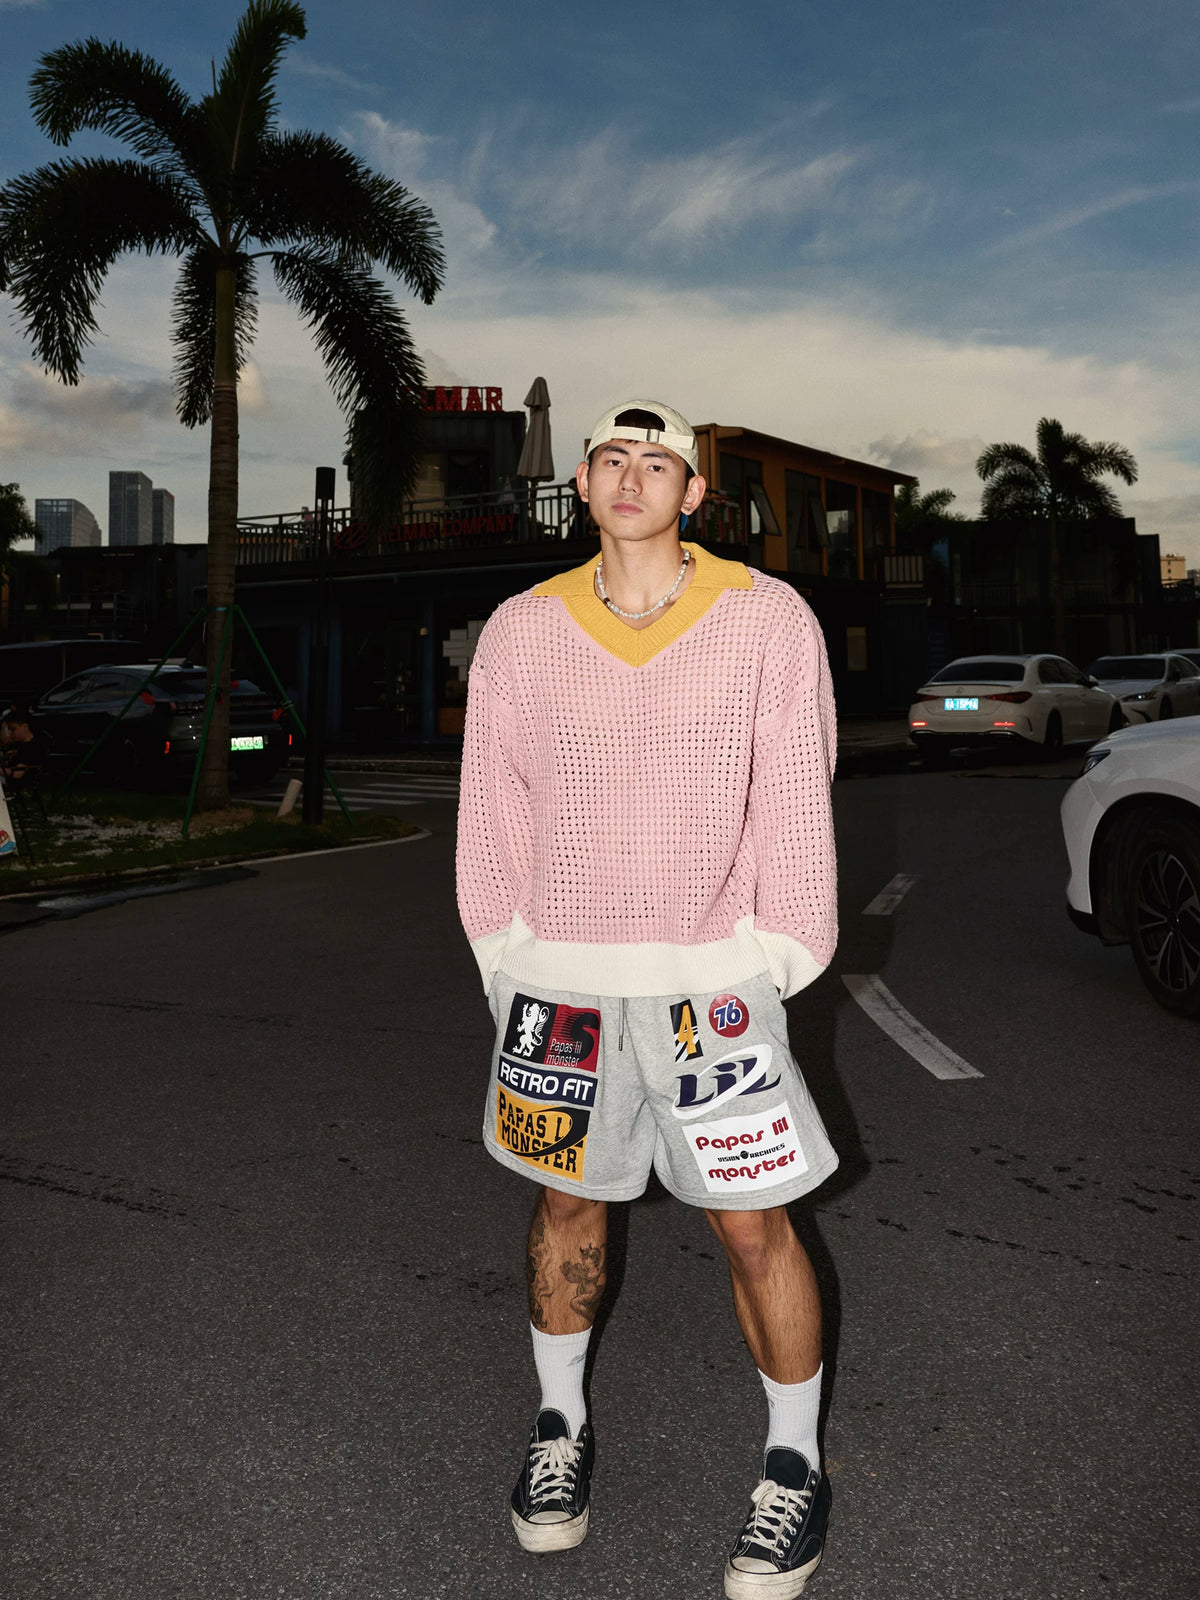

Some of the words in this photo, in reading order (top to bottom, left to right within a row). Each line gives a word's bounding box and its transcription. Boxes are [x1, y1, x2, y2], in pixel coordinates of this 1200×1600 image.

[442, 514, 516, 537] COMPANY
[714, 999, 741, 1031] 76
[550, 1038, 573, 1055] Papas
[546, 1054, 580, 1067] monster
[500, 1061, 559, 1094] RETRO
[562, 1075, 594, 1101] FIT
[499, 1091, 547, 1138] PAPAS
[772, 1117, 789, 1136] lil
[750, 1143, 785, 1158] ARCHIVES
[708, 1150, 796, 1181] monster
